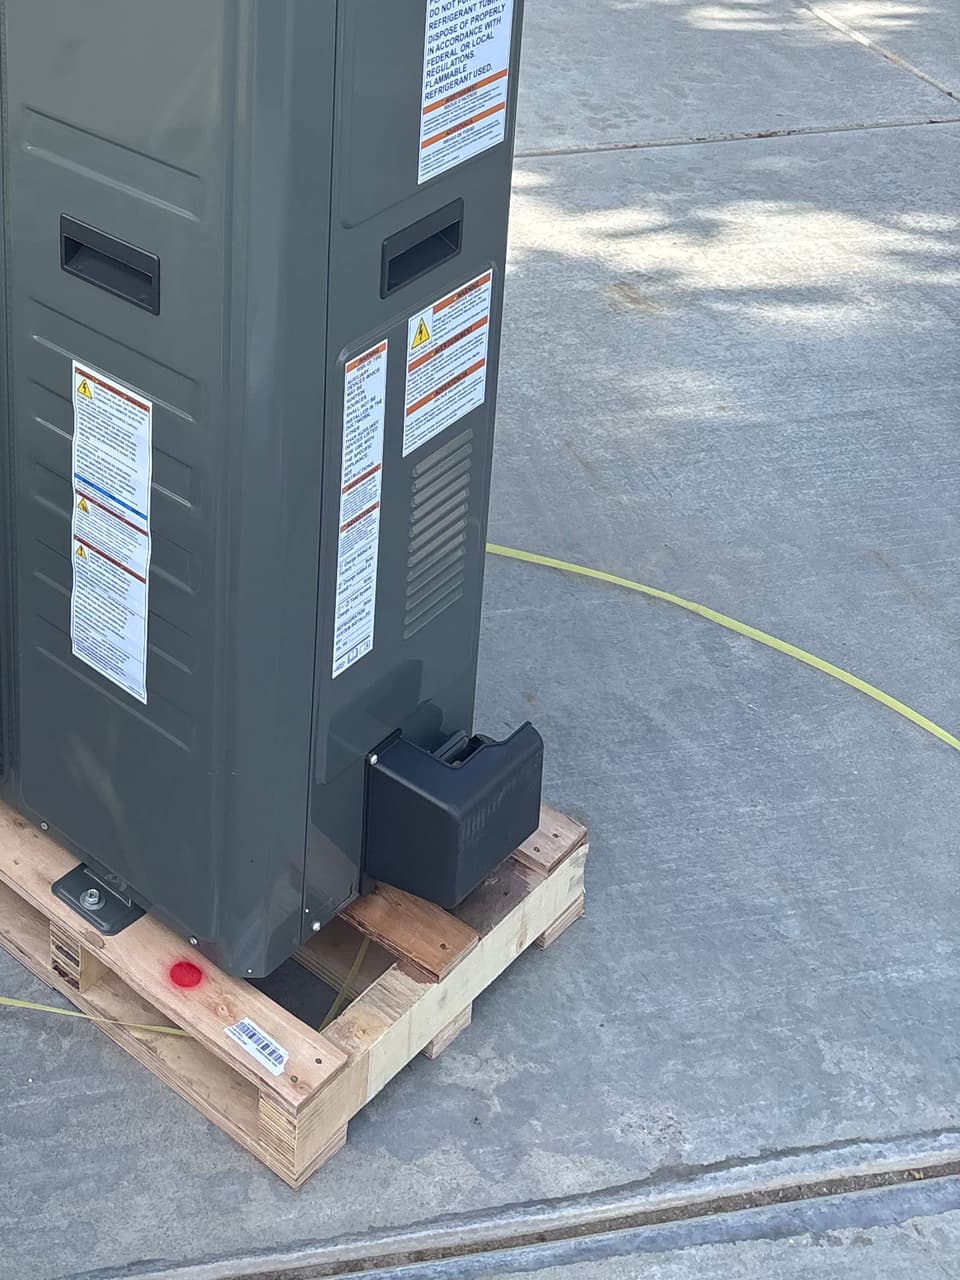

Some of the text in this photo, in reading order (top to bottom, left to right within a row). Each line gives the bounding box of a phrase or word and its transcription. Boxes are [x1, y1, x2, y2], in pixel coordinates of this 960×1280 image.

[428, 3, 477, 31] REFRIGERANT
[428, 3, 506, 44] DISPOSE OF PROPERLY
[429, 7, 440, 18] DO
[441, 0, 456, 13] NOT
[427, 16, 501, 56] IN ACCORDANCE WITH
[427, 32, 494, 68] FEDERAL OR LOCAL
[424, 71, 473, 101] REFRIGERANT
[426, 64, 468, 90] FLAMMABLE
